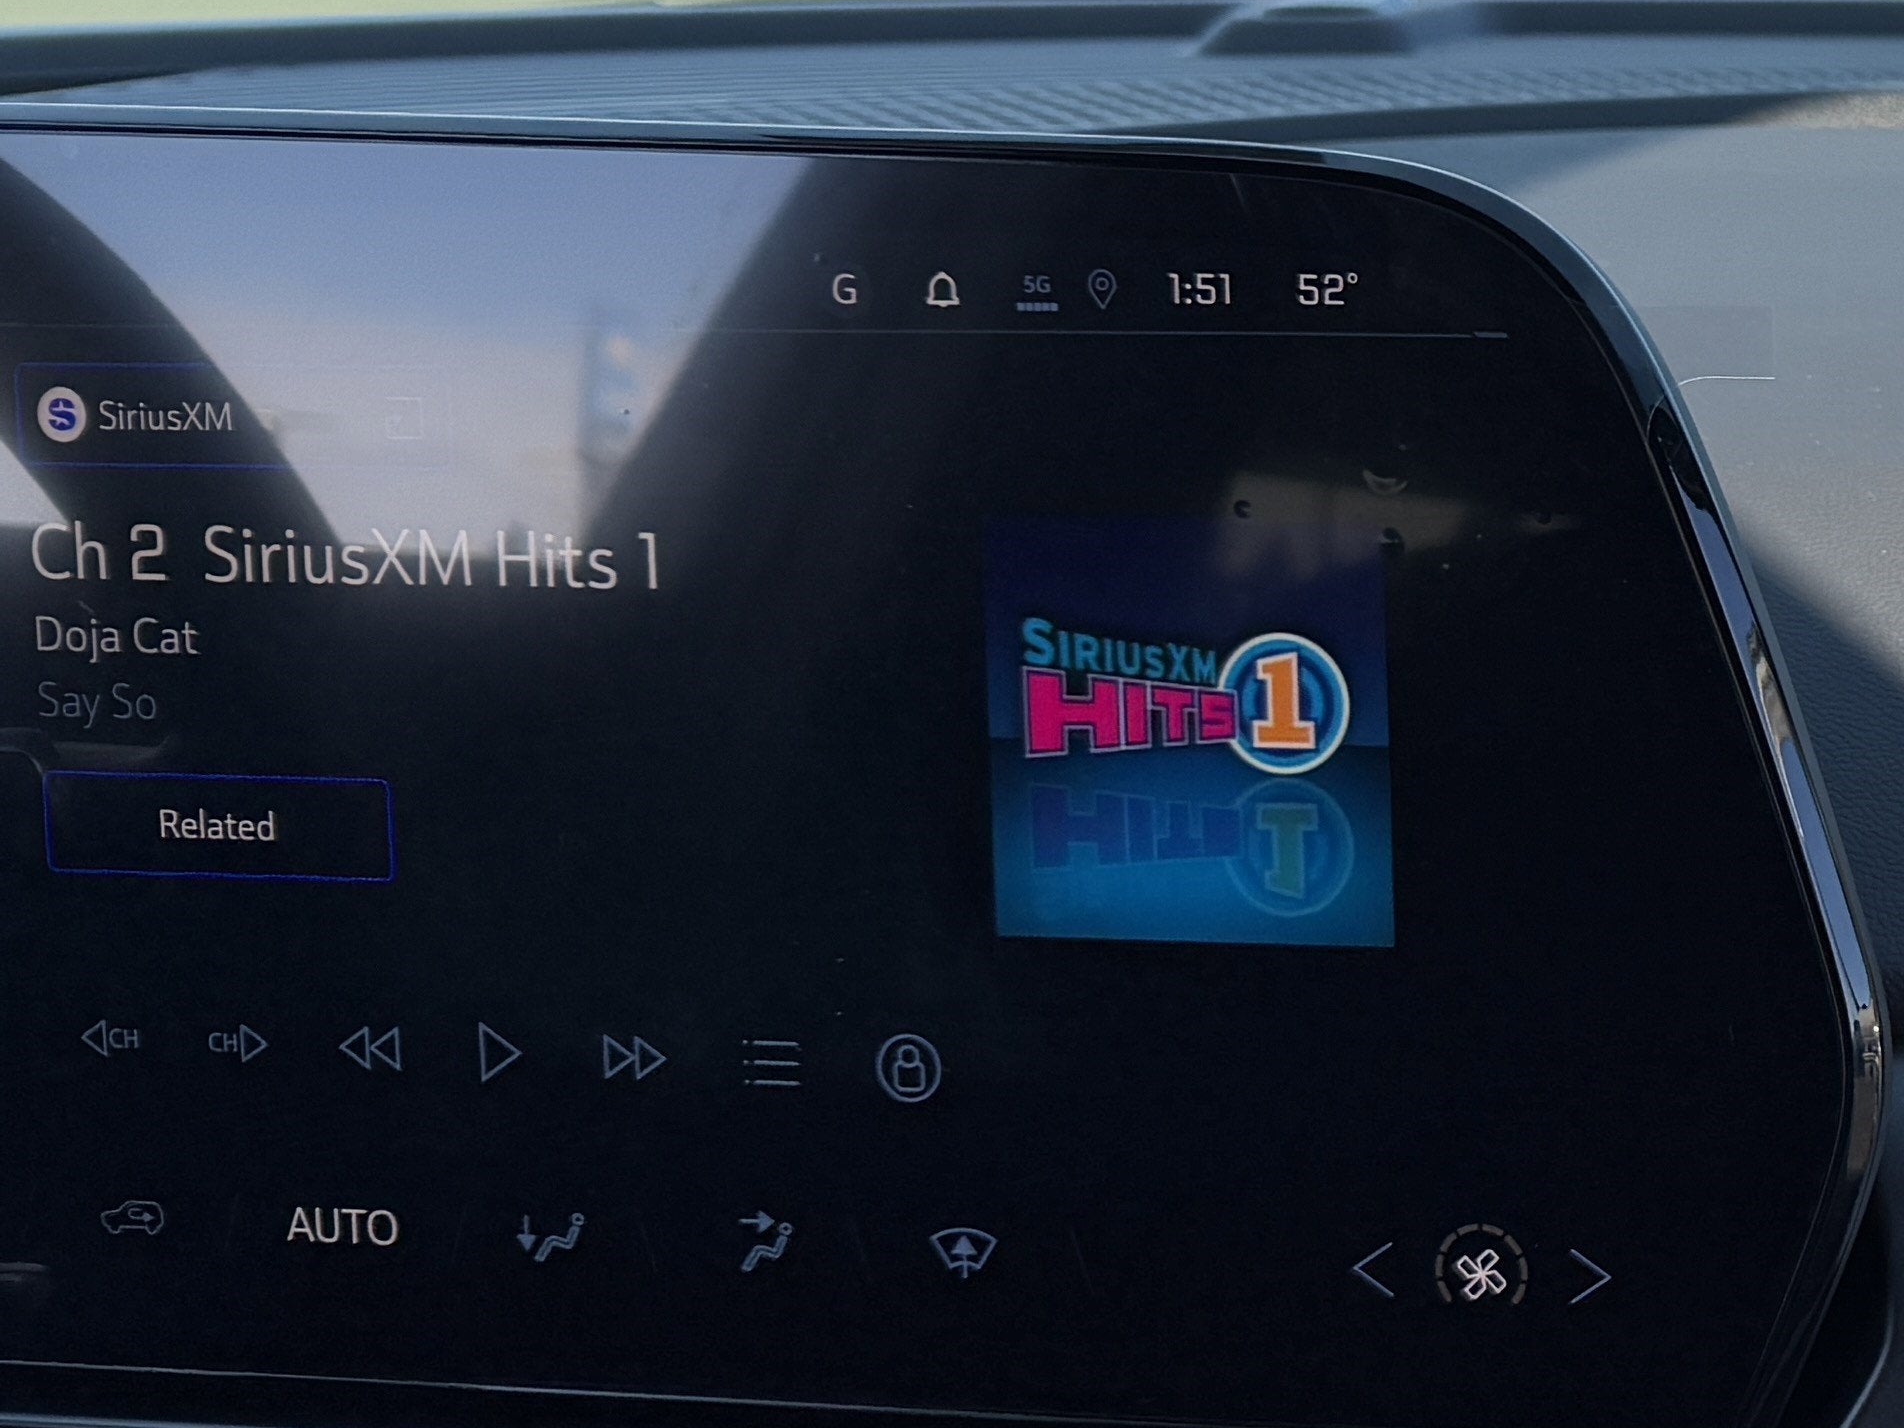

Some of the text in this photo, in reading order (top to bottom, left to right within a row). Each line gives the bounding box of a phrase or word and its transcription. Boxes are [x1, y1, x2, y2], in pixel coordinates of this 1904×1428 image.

[832, 273, 857, 305] G
[1023, 274, 1051, 294] 5G
[1168, 272, 1231, 305] 1:51
[1298, 272, 1358, 306] 52°
[99, 400, 232, 431] SiriusXM
[30, 520, 658, 590] Ch 2 SiriusXM Hits 1
[35, 615, 198, 664] Doja Cat
[38, 681, 157, 729] Say So
[1020, 652, 1317, 758] HITS 1
[159, 808, 275, 841] Related
[108, 1027, 139, 1049] CH
[208, 1031, 238, 1053] CH
[287, 1206, 398, 1246] AUTO
